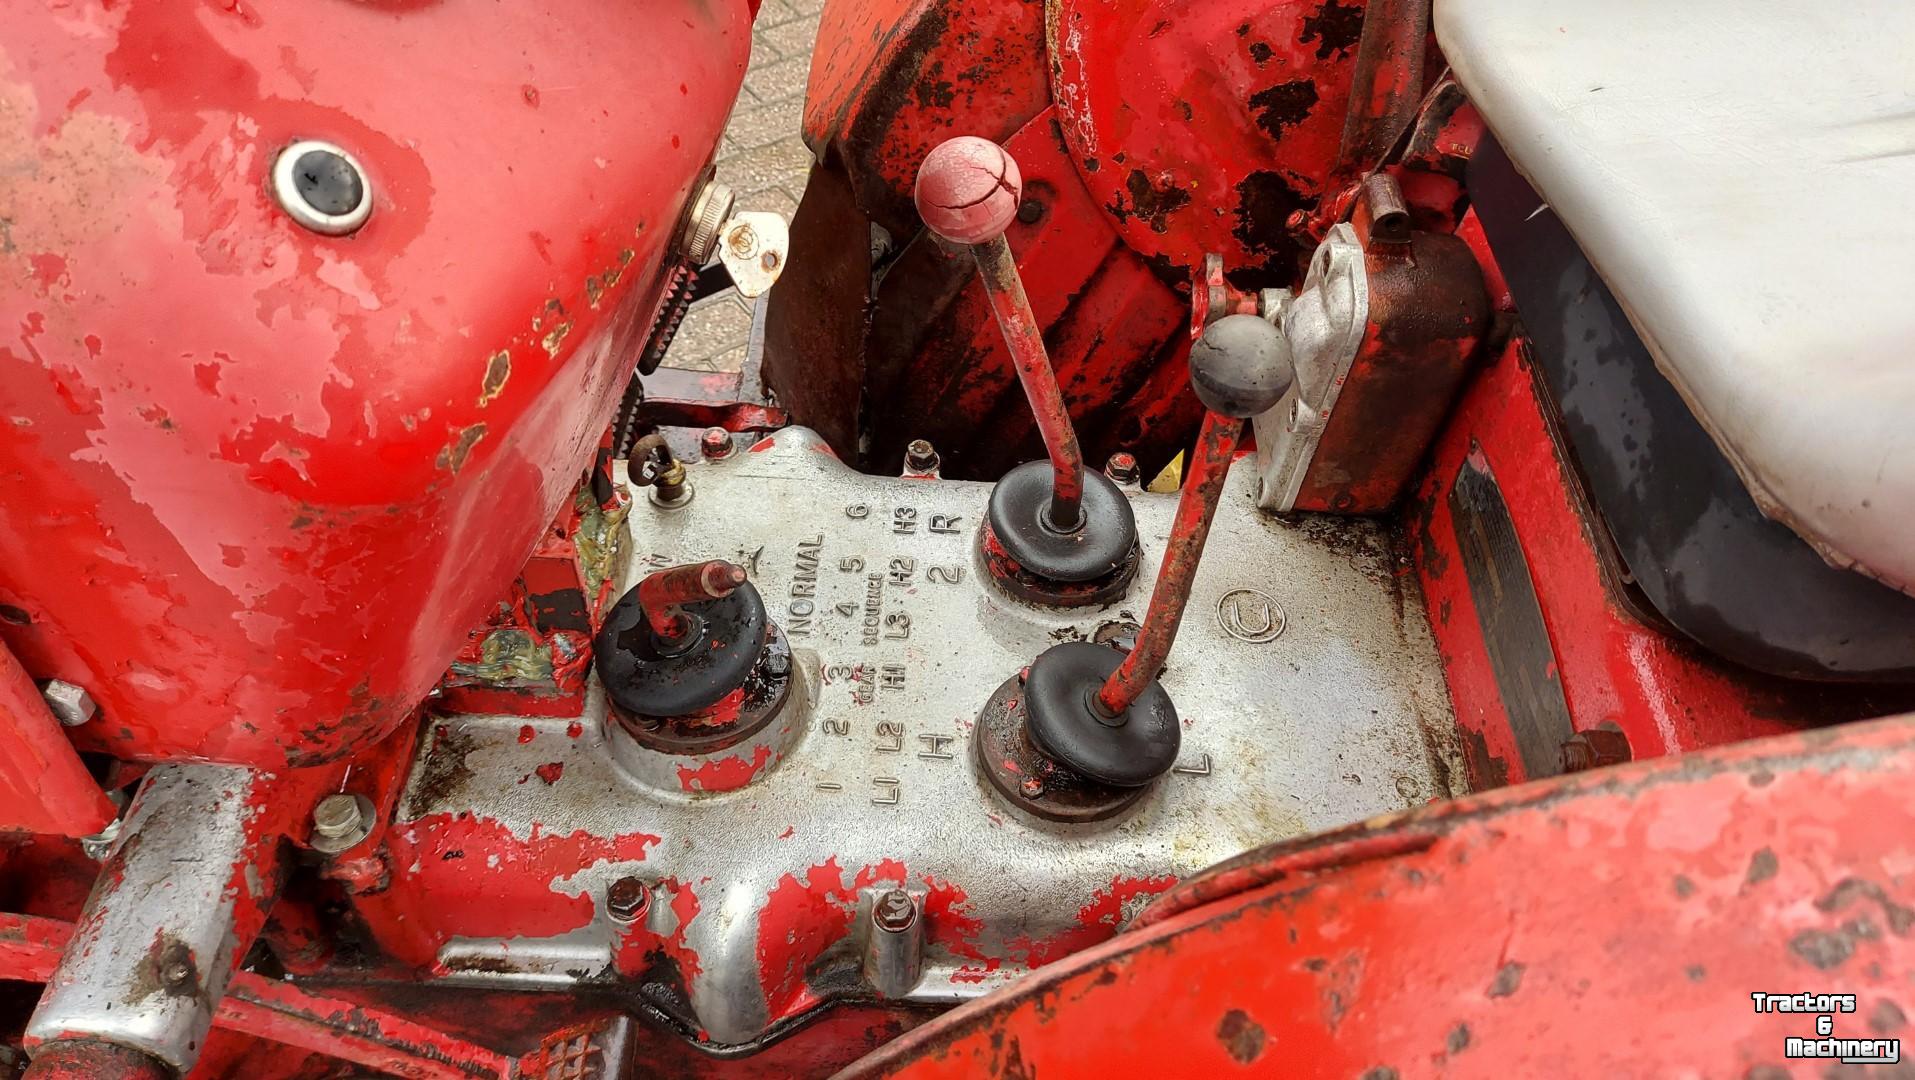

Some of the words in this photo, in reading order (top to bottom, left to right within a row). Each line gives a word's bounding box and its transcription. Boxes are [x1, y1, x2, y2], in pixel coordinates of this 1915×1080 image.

[845, 503, 869, 519] 6
[893, 506, 917, 535] H3
[929, 513, 963, 535] R
[840, 555, 865, 573] 5
[889, 557, 915, 587] H2
[926, 564, 962, 585] 2
[787, 534, 823, 636] NORMAL
[836, 601, 859, 618] 4
[863, 572, 882, 646] SEQUENCE
[885, 612, 911, 641] L3
[828, 665, 852, 681] 3
[858, 665, 876, 704] GEAR
[823, 717, 850, 736] 2
[875, 719, 904, 752] L2
[918, 733, 954, 760] H
[1172, 753, 1211, 774] L
